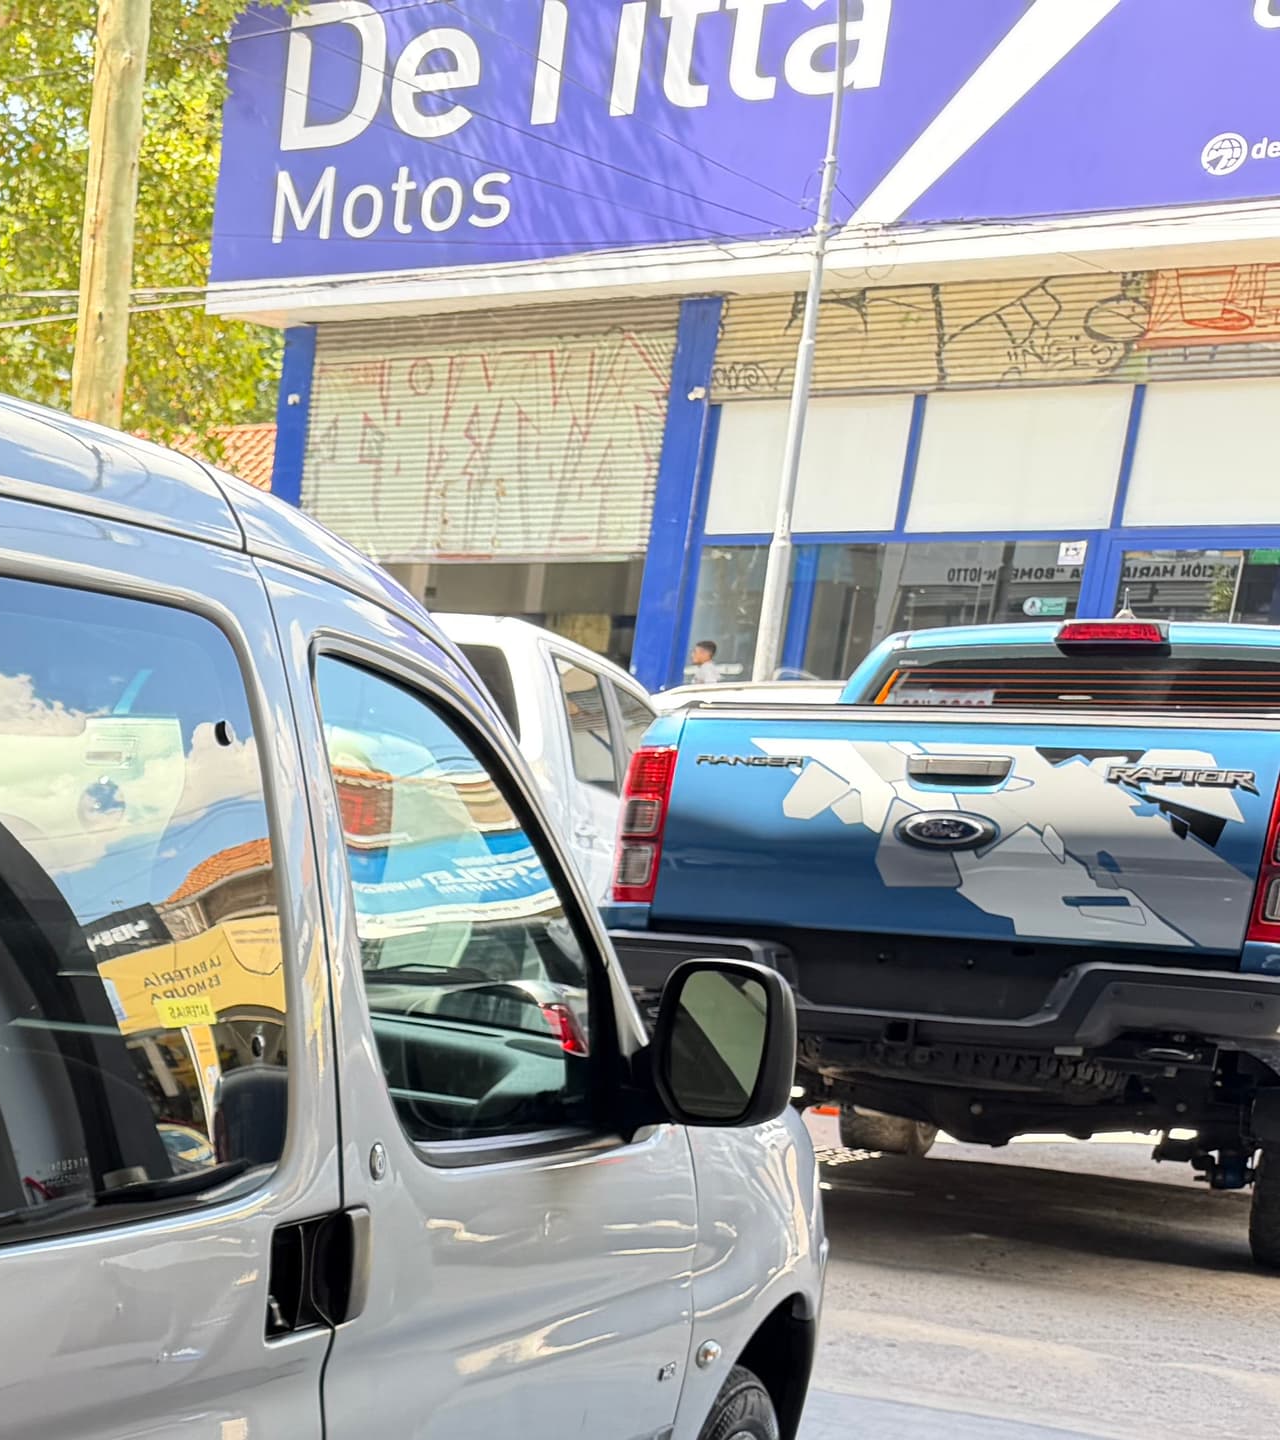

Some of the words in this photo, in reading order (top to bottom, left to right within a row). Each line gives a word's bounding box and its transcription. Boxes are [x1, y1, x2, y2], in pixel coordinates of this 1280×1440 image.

[280, 0, 481, 151] De
[271, 165, 512, 244] Motos
[696, 754, 804, 768] RANGER
[1106, 766, 1261, 797] RAPTOR
